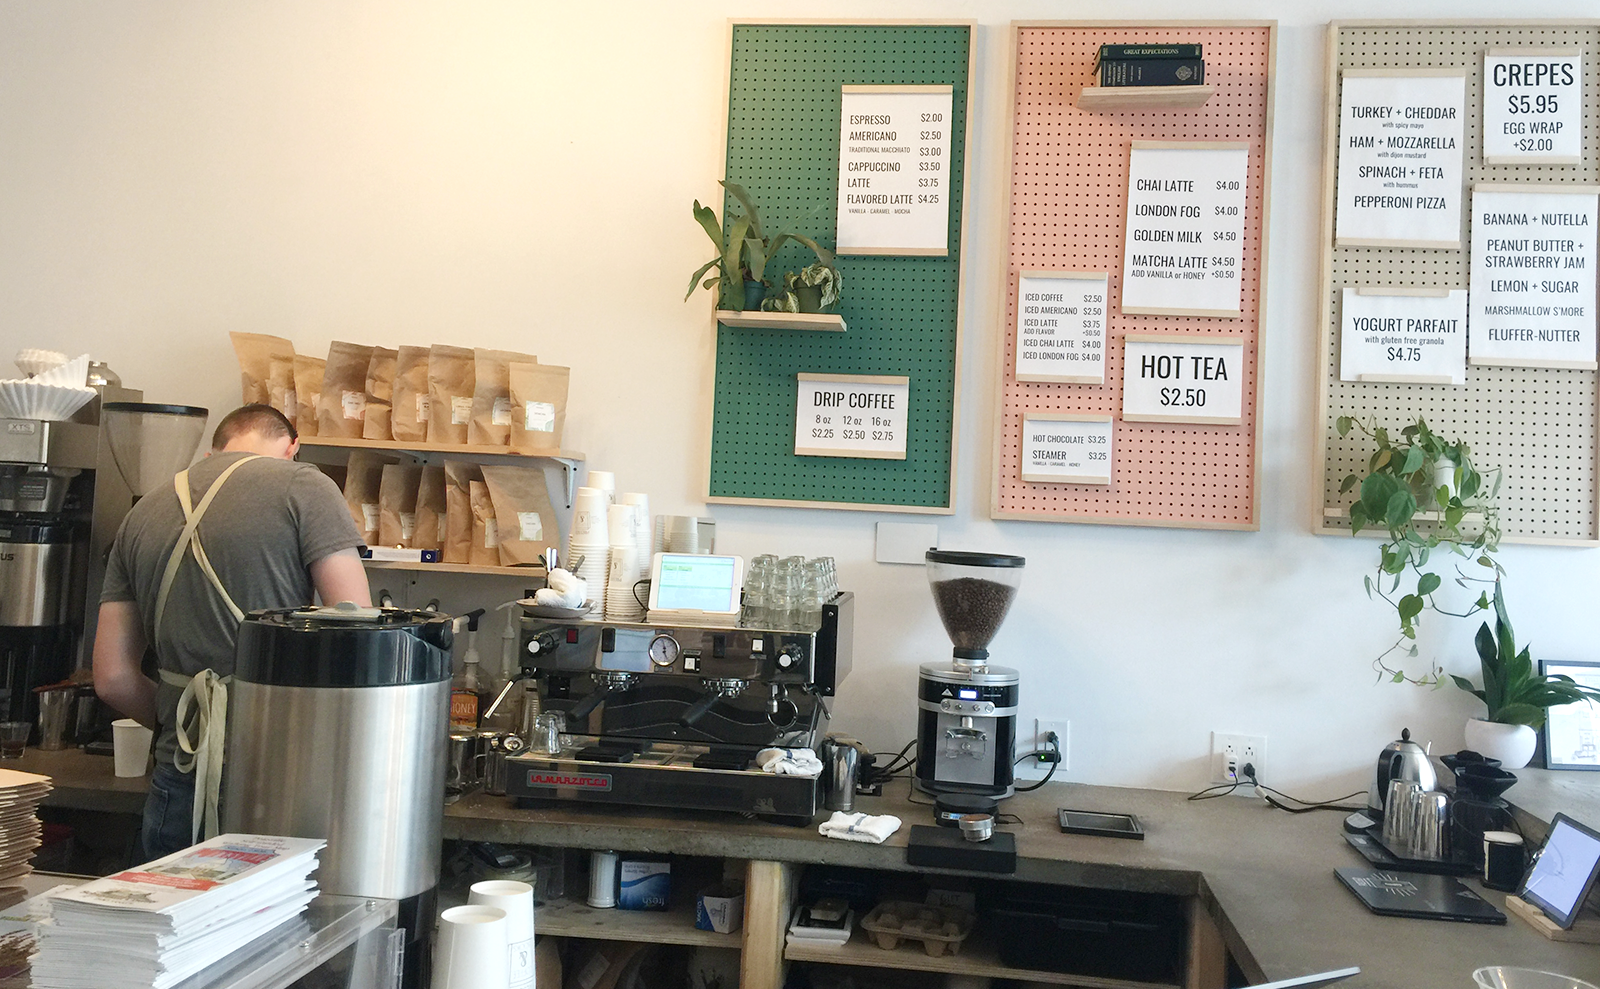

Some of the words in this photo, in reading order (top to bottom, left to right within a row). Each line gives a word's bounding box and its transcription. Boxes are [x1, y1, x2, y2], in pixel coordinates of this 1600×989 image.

[1494, 63, 1574, 86] CREPES
[1509, 94, 1558, 114] $5.95
[850, 115, 890, 124] ESPRESSO
[921, 113, 942, 122] $2.00
[1352, 107, 1392, 118] TURKEY
[1405, 107, 1456, 119] CHEDDAR
[1504, 122, 1525, 134] EGG
[1530, 122, 1563, 133] WRAP
[849, 131, 897, 141] AMERICANO
[920, 131, 941, 140] $2.50
[1350, 137, 1374, 148] HAM
[1388, 137, 1455, 149] MOZZARELLA
[1514, 139, 1552, 151] +$2.00
[920, 147, 941, 157] $3.00
[848, 162, 900, 172] CAPPUCCINO
[919, 162, 940, 171] $3.50
[1359, 166, 1406, 178] SPINACH
[1419, 167, 1443, 179] FETA
[848, 178, 870, 188] LATTE
[918, 178, 938, 187] $3.75
[1137, 179, 1161, 191] CHAI
[1165, 180, 1194, 192] LATTE
[1216, 181, 1239, 190] $4.00
[847, 194, 888, 204] FLAVORED
[890, 195, 913, 204] LATTE
[918, 194, 939, 203] $4.25
[1354, 196, 1412, 208] PEPPERONI
[1417, 198, 1446, 209] PIZZA
[1136, 204, 1177, 217] LONDON
[1181, 206, 1200, 218] FOG
[1215, 207, 1238, 216] $4.00
[1484, 214, 1528, 225] BANANA
[1542, 214, 1588, 226] NUTELLA
[1134, 230, 1173, 242] GOLDEN
[1177, 231, 1202, 243] MILK
[1213, 232, 1236, 241] $4.50
[1487, 239, 1529, 251] PEANUT
[1533, 240, 1574, 252] BUTTER
[1133, 255, 1175, 267] MATCHA
[1179, 257, 1208, 268] LATTE
[1212, 257, 1235, 266] $4.50
[1486, 256, 1560, 268] STRAWBERRY
[1564, 257, 1585, 268] JAM
[1147, 270, 1173, 279] VANILLA
[1183, 271, 1205, 279] HONEY
[1491, 280, 1528, 292] LEMON
[1542, 281, 1578, 293] SUGAR
[1485, 306, 1550, 316] MARSHMALLOW
[1553, 307, 1584, 316] S'MORE
[1353, 318, 1403, 331] YOGURT
[1407, 319, 1458, 332] PARFAIT
[1489, 329, 1580, 342] FLUFFER-NUTTER
[1387, 347, 1420, 361] $4.75
[1142, 355, 1184, 378] HOT
[1191, 357, 1227, 380] TEA
[814, 391, 844, 407] DRIP
[849, 393, 895, 409] COFFEE
[1161, 387, 1206, 406] $2.50
[816, 415, 820, 423] 8
[843, 416, 852, 425] 12
[872, 417, 880, 426] 16
[812, 428, 834, 438] $2.25
[843, 430, 865, 440] $2.50
[872, 431, 893, 441] $2.75
[1047, 436, 1084, 444] CHOCOLATE
[1033, 450, 1066, 460] STEAMER
[1089, 452, 1106, 460] $3.25
[643, 897, 665, 906] fresh
